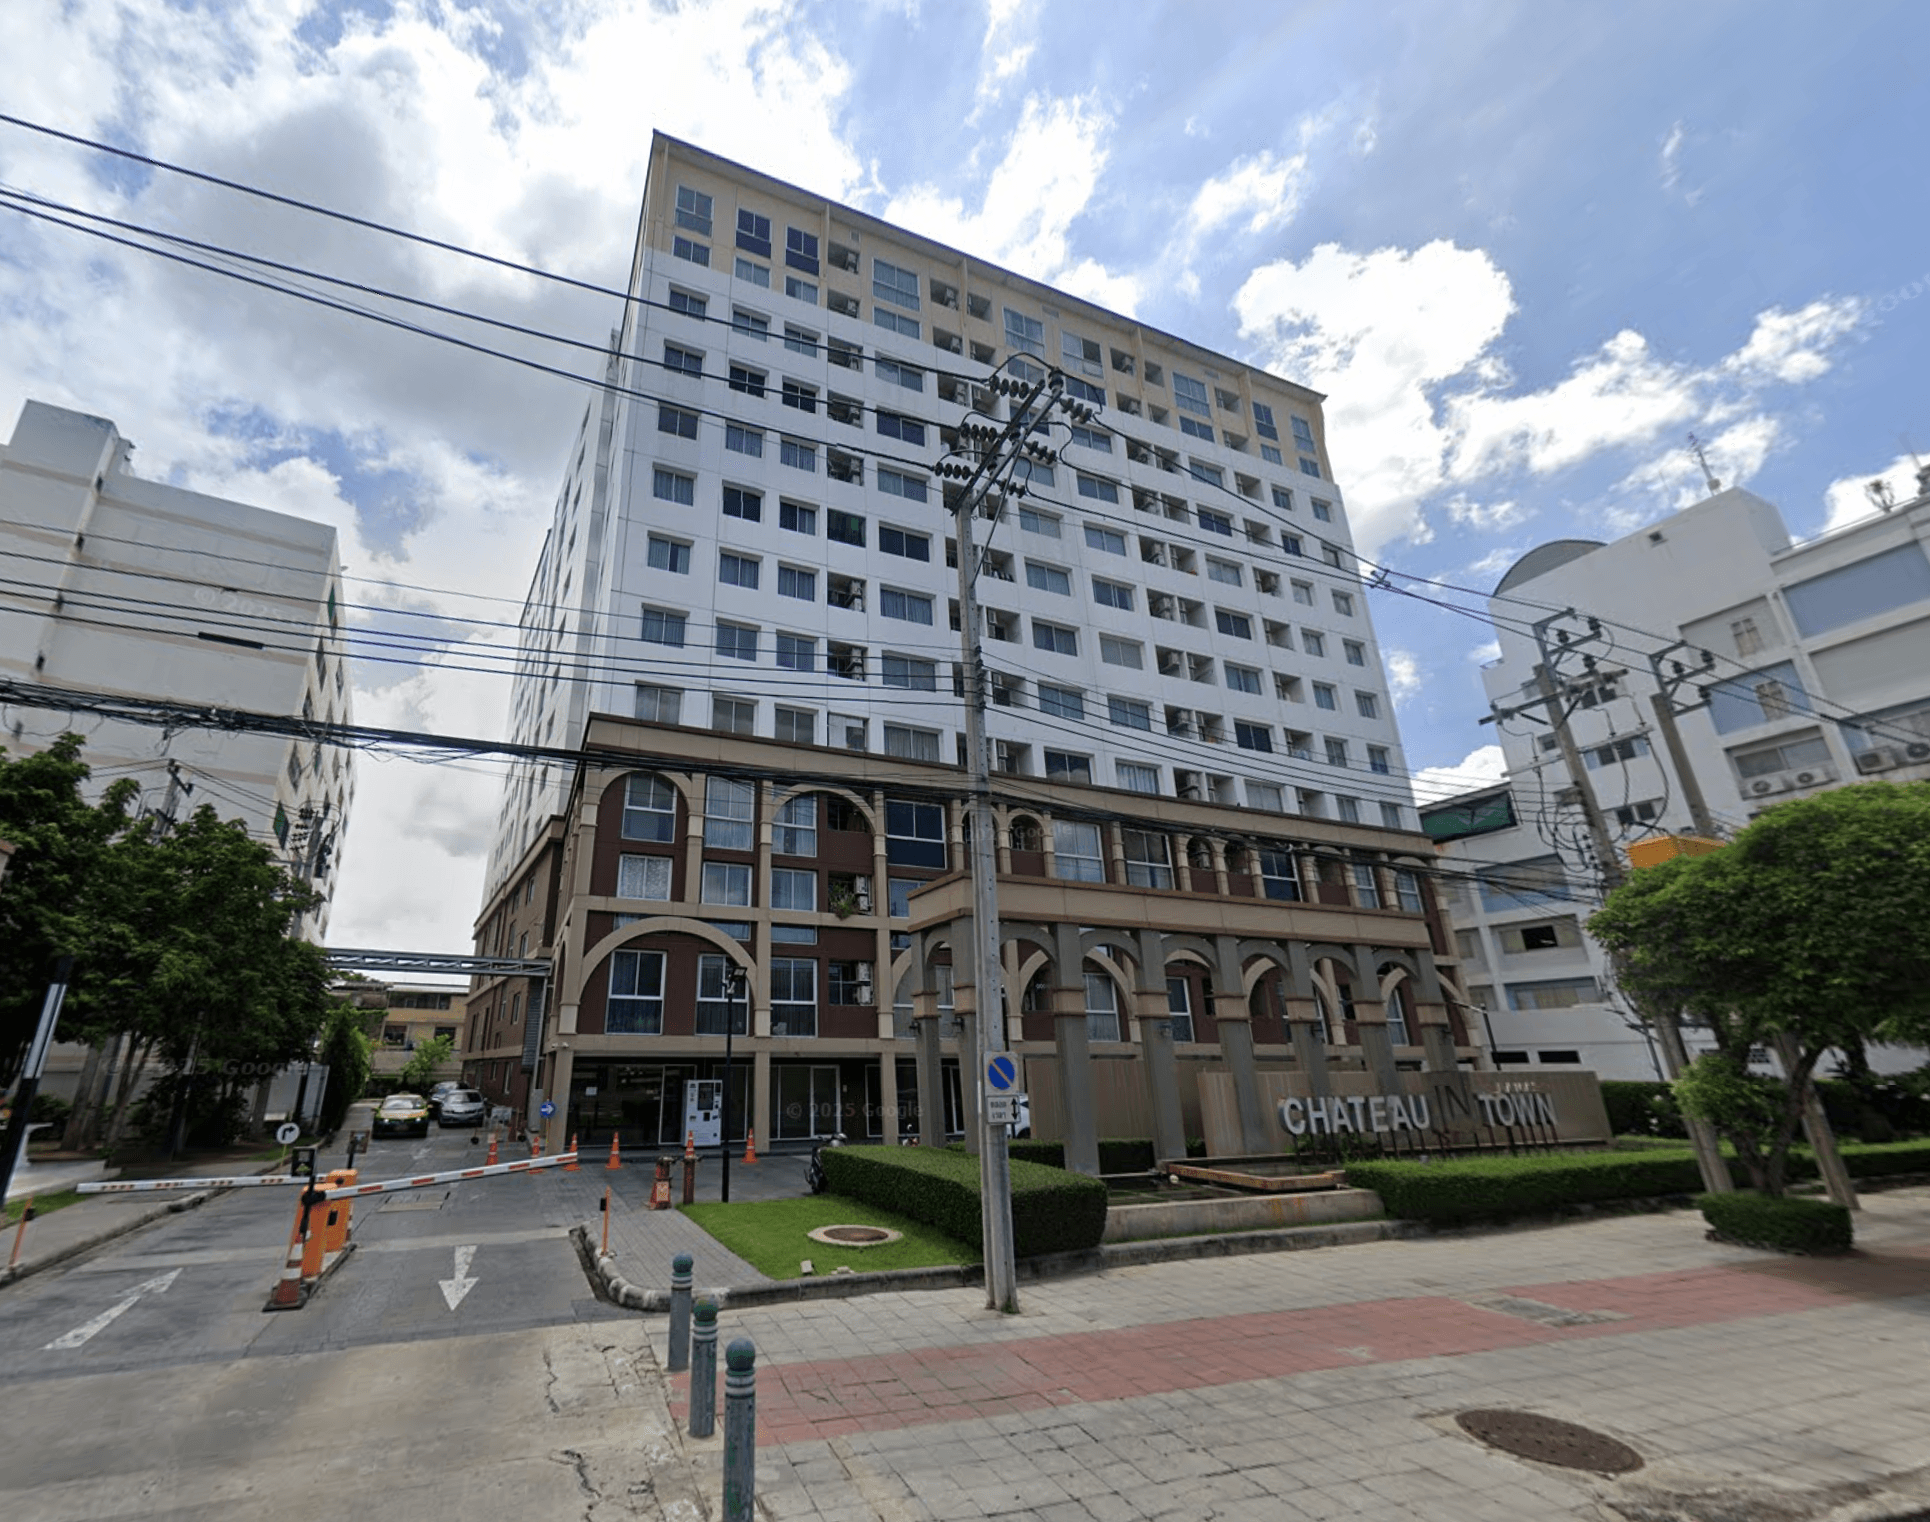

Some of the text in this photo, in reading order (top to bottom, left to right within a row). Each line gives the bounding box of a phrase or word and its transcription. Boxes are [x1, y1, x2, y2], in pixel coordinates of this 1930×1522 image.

[1280, 1076, 1558, 1135] CHATEAU IN TOWN
